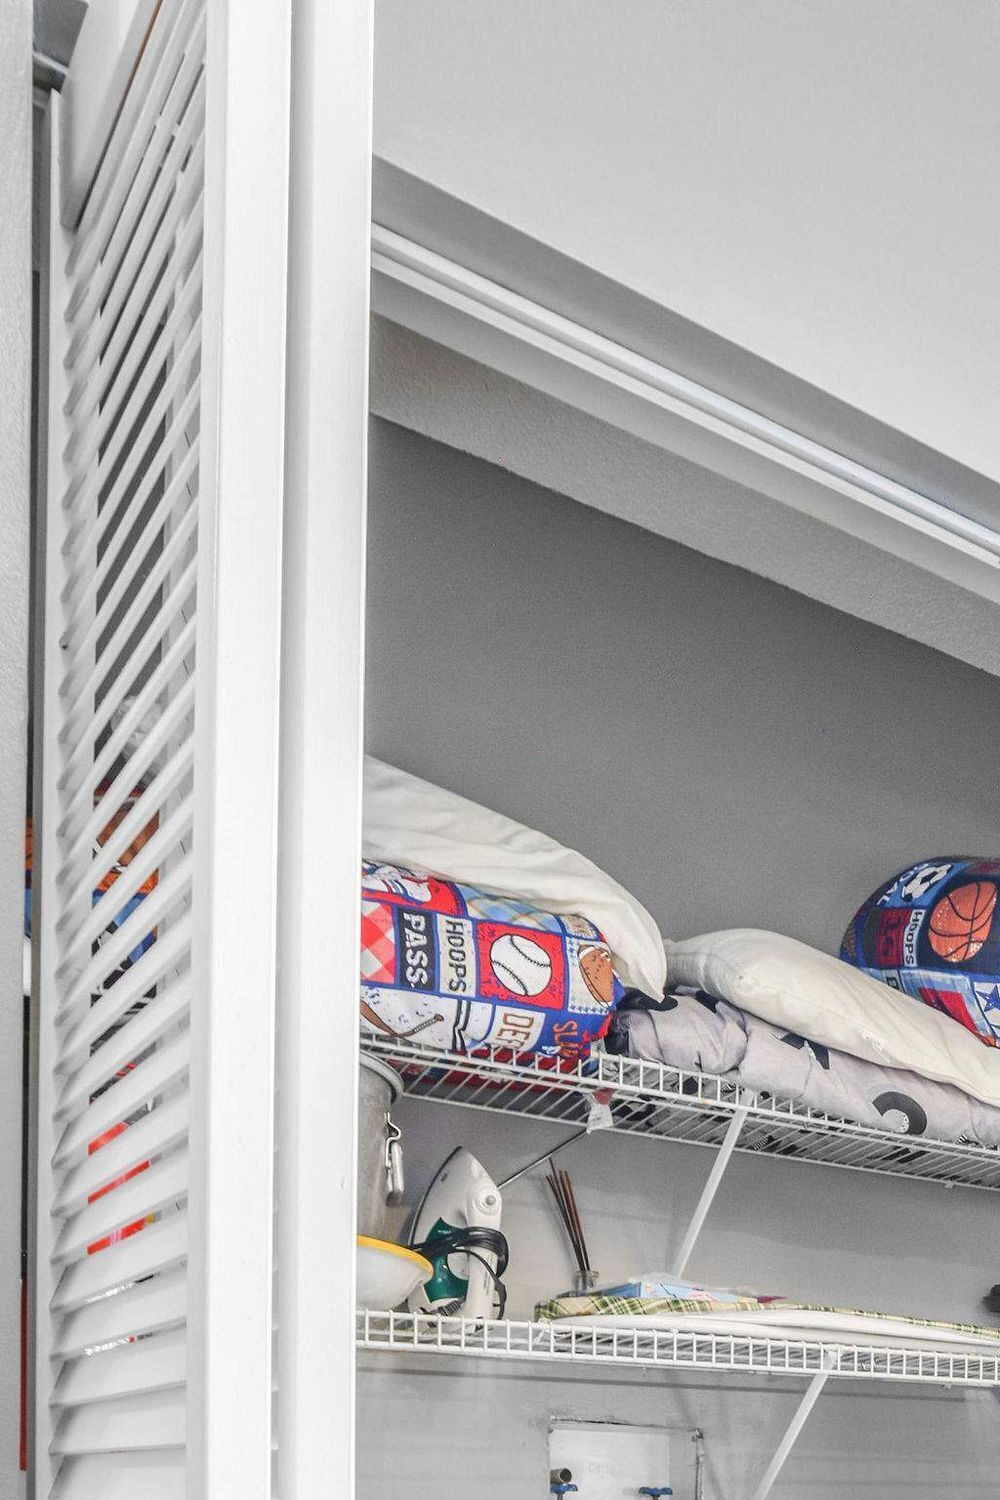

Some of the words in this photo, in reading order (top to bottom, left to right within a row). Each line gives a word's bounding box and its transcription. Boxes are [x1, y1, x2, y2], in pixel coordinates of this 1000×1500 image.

[402, 911, 430, 989] PASS
[443, 918, 468, 994] HOOPS
[904, 910, 923, 965] HOOPS
